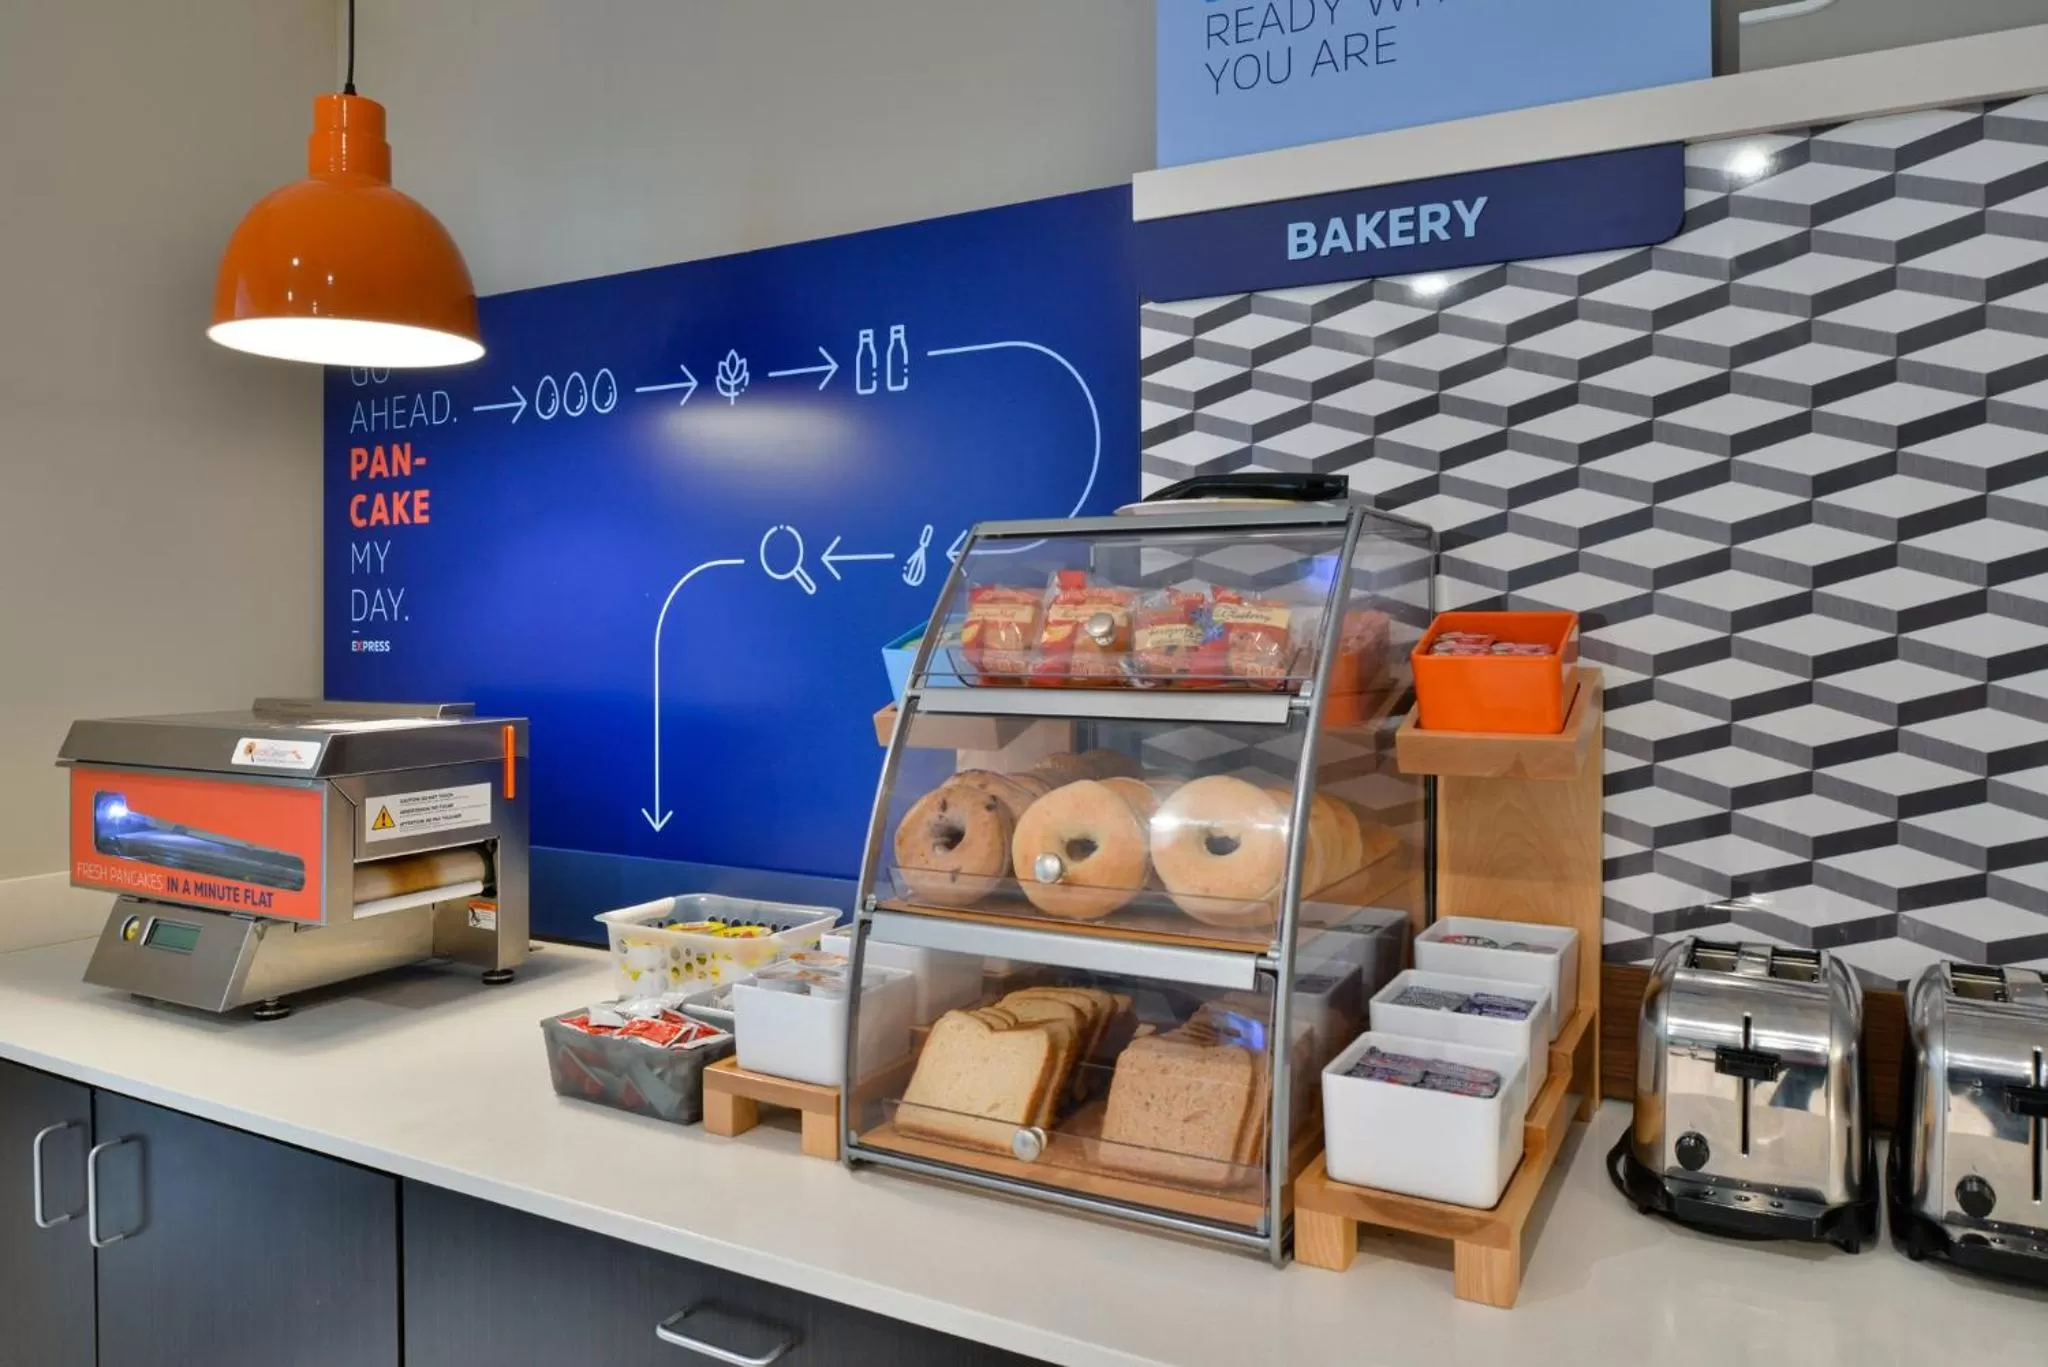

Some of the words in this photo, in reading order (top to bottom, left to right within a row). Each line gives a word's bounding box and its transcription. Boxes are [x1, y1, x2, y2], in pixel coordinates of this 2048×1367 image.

[1206, 0, 1340, 50] READY
[1205, 46, 1292, 95] YOU
[1311, 25, 1397, 78] ARE
[1286, 196, 1489, 261] BAKERY
[350, 390, 457, 434] AHEAD.
[350, 442, 427, 481] PAN-
[350, 489, 431, 528] CAKE
[351, 540, 392, 575] MY
[351, 587, 409, 622] DAY.
[351, 640, 390, 652] EXPRESS
[76, 862, 107, 880] FRESH
[109, 867, 164, 891] PANCAKES
[167, 876, 179, 893] IN
[182, 879, 191, 894] A
[194, 880, 240, 903] MINUTE
[243, 889, 274, 908] FLAT
